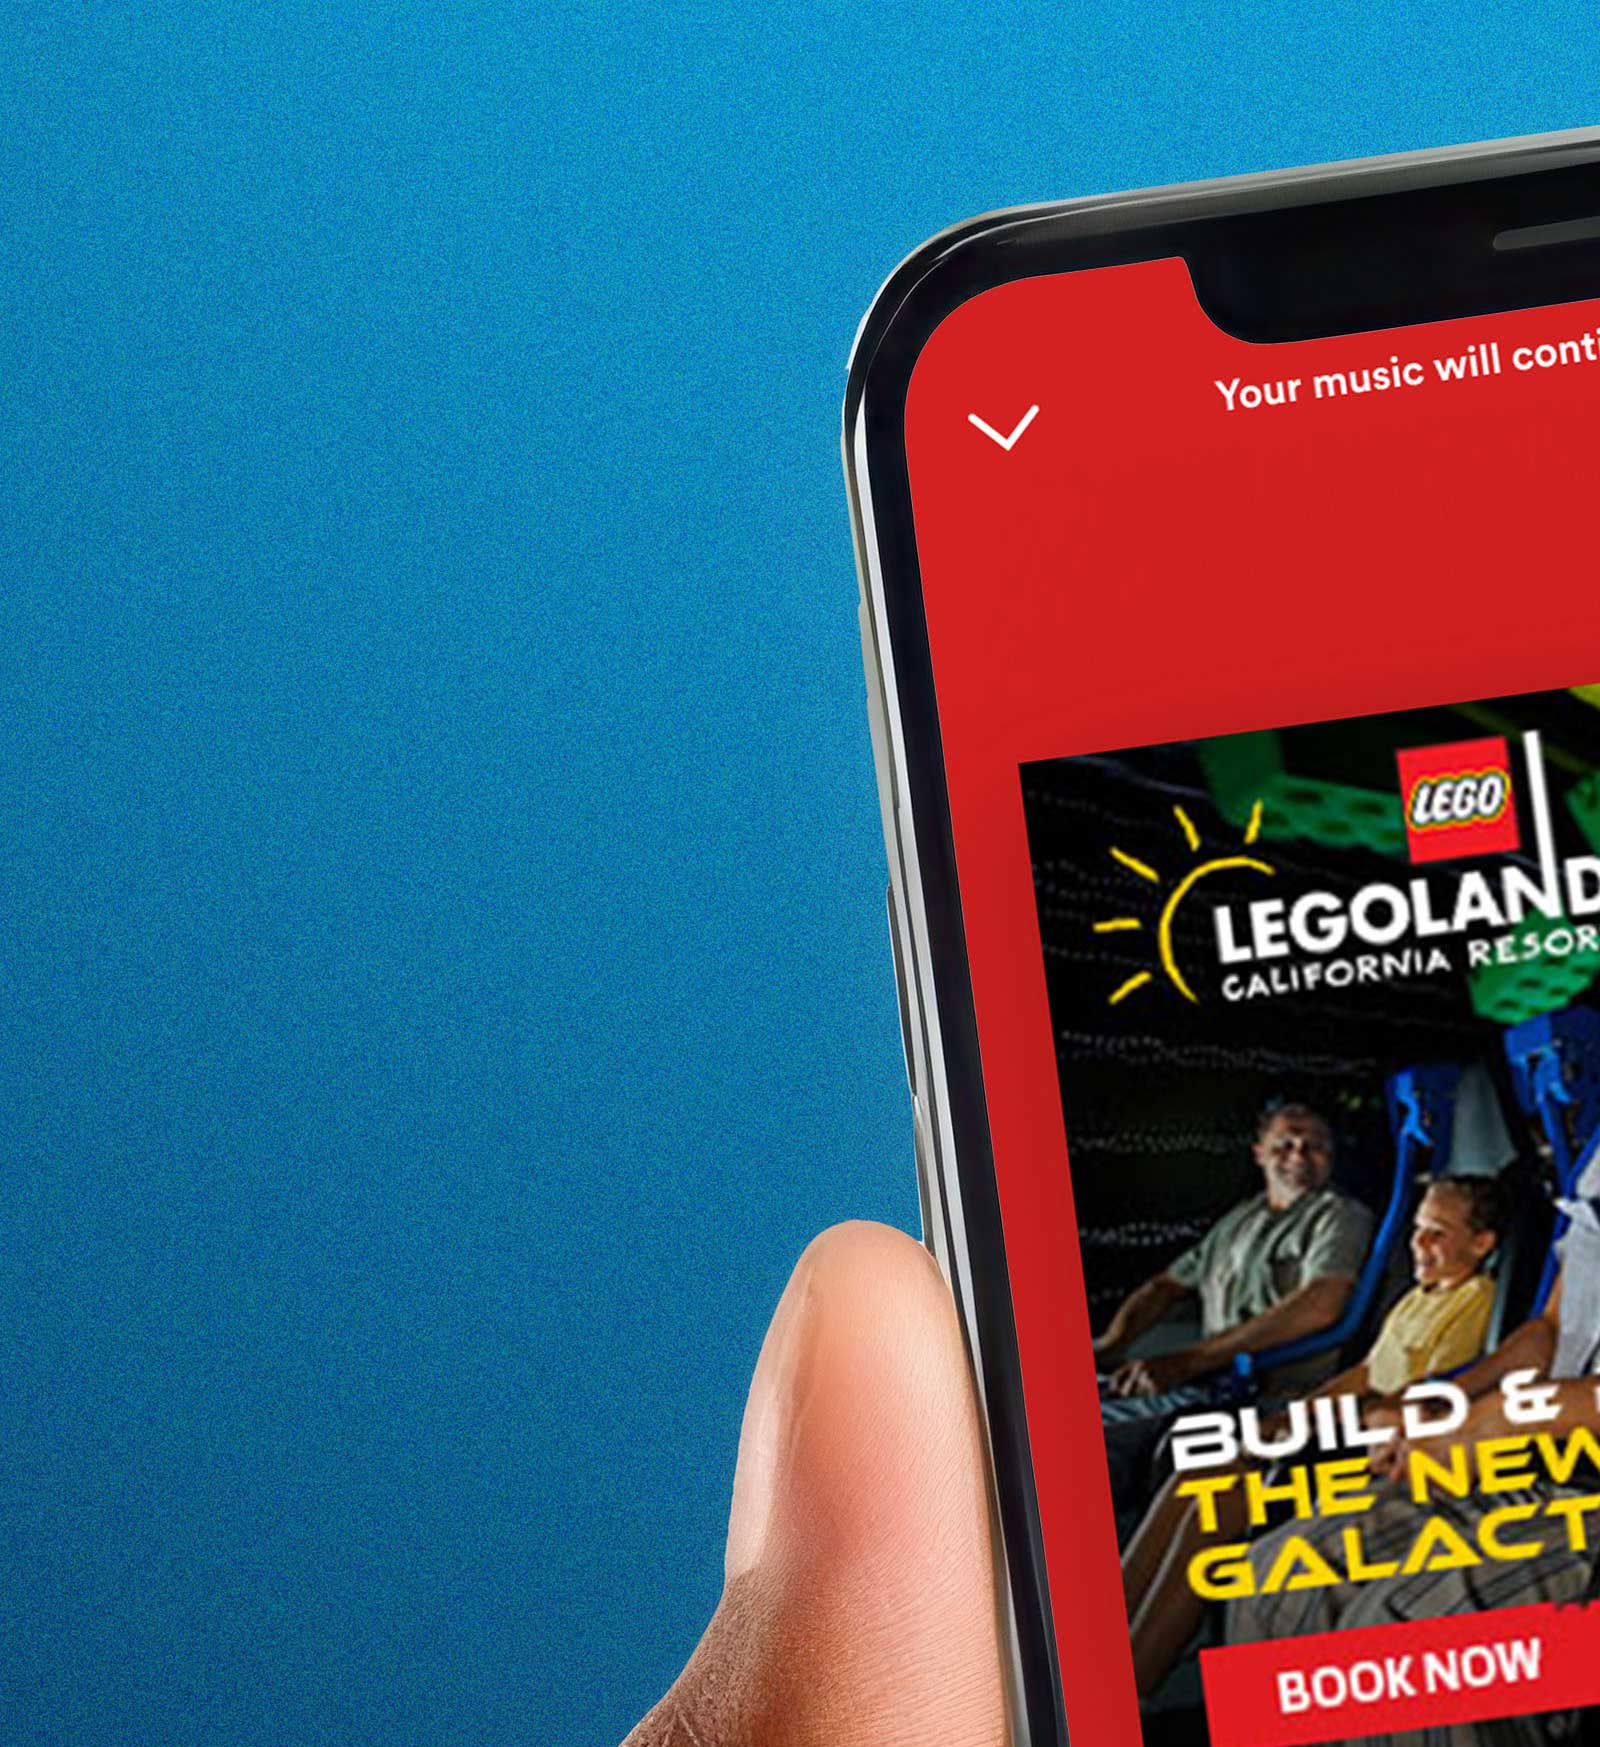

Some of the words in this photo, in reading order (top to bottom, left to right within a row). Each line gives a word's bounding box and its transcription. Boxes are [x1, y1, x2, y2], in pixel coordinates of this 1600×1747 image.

[1215, 377, 1302, 411] Your
[1313, 356, 1425, 398] music
[1434, 341, 1501, 382] will
[1410, 774, 1502, 824] LEGO
[1222, 945, 1451, 1002] CALIFORNIA
[1171, 1381, 1470, 1471] BUILD
[1501, 1367, 1564, 1425] &
[1175, 1456, 1377, 1533] THE
[1277, 1655, 1416, 1714] BOOK
[1423, 1637, 1541, 1692] NOW
